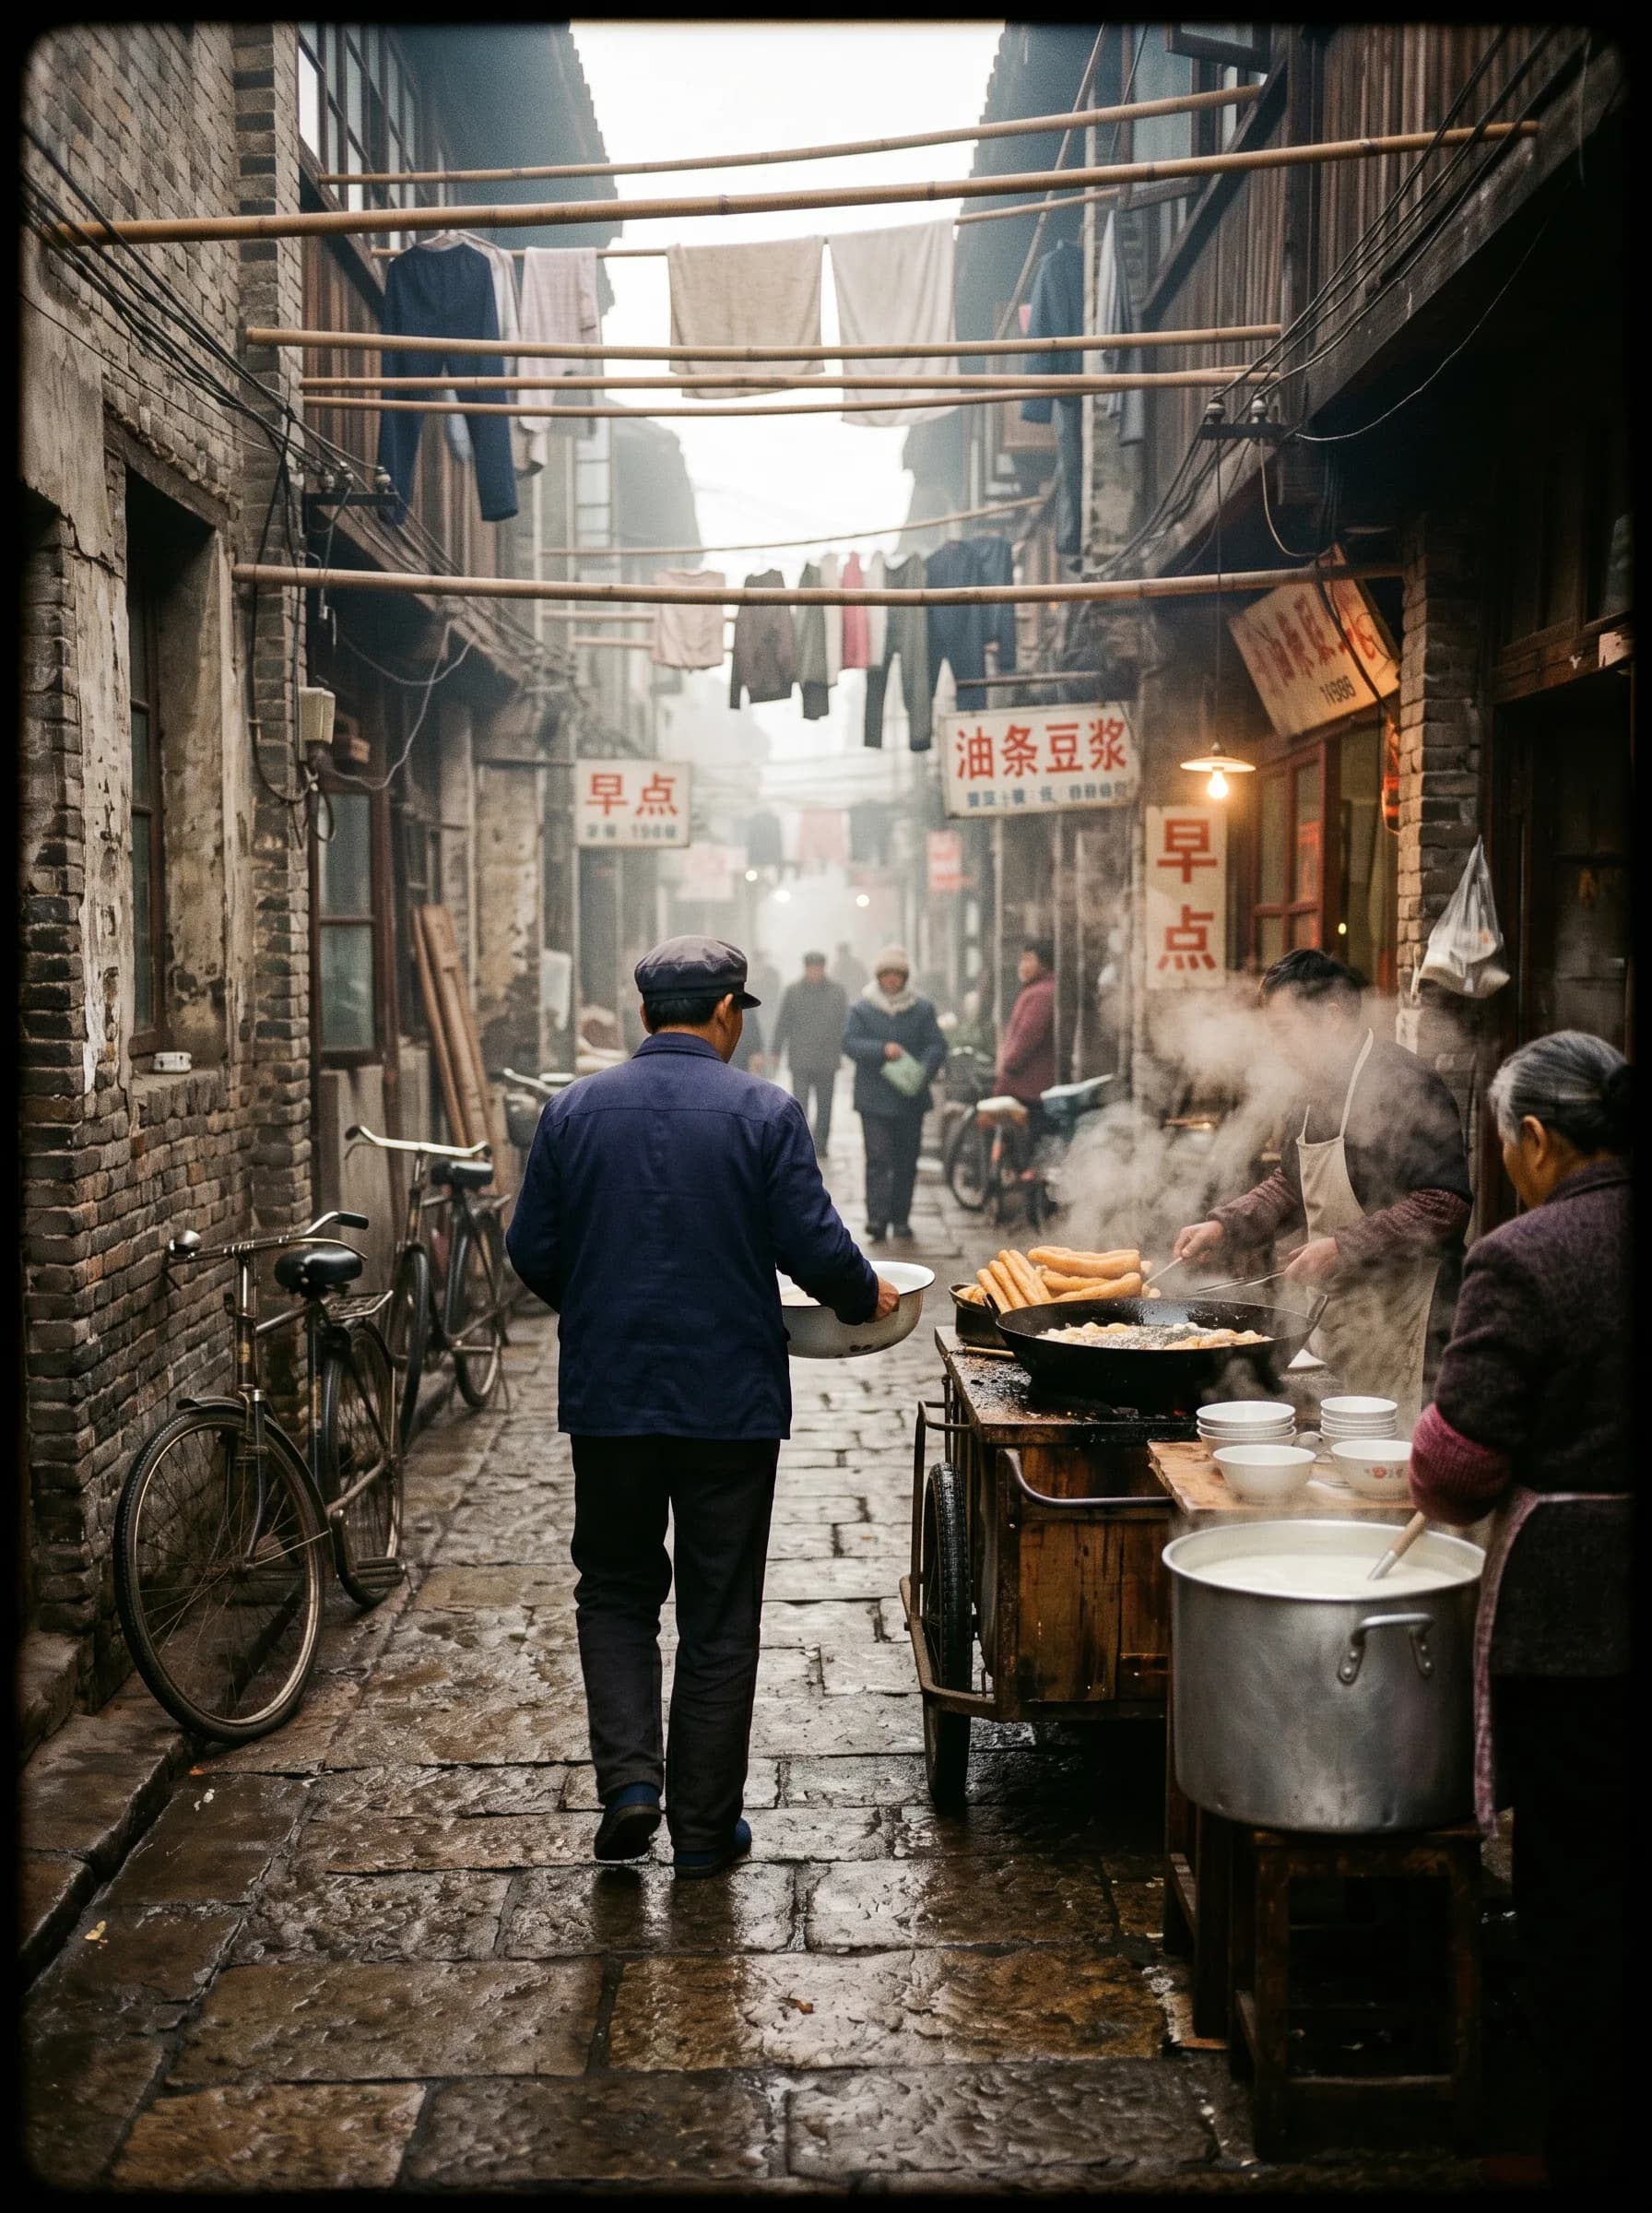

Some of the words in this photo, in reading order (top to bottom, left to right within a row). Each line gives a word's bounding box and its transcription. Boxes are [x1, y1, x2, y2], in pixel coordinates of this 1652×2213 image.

[956, 717, 1127, 780] 油条豆浆
[584, 773, 678, 816] 早点
[1157, 819, 1218, 971] 早点
